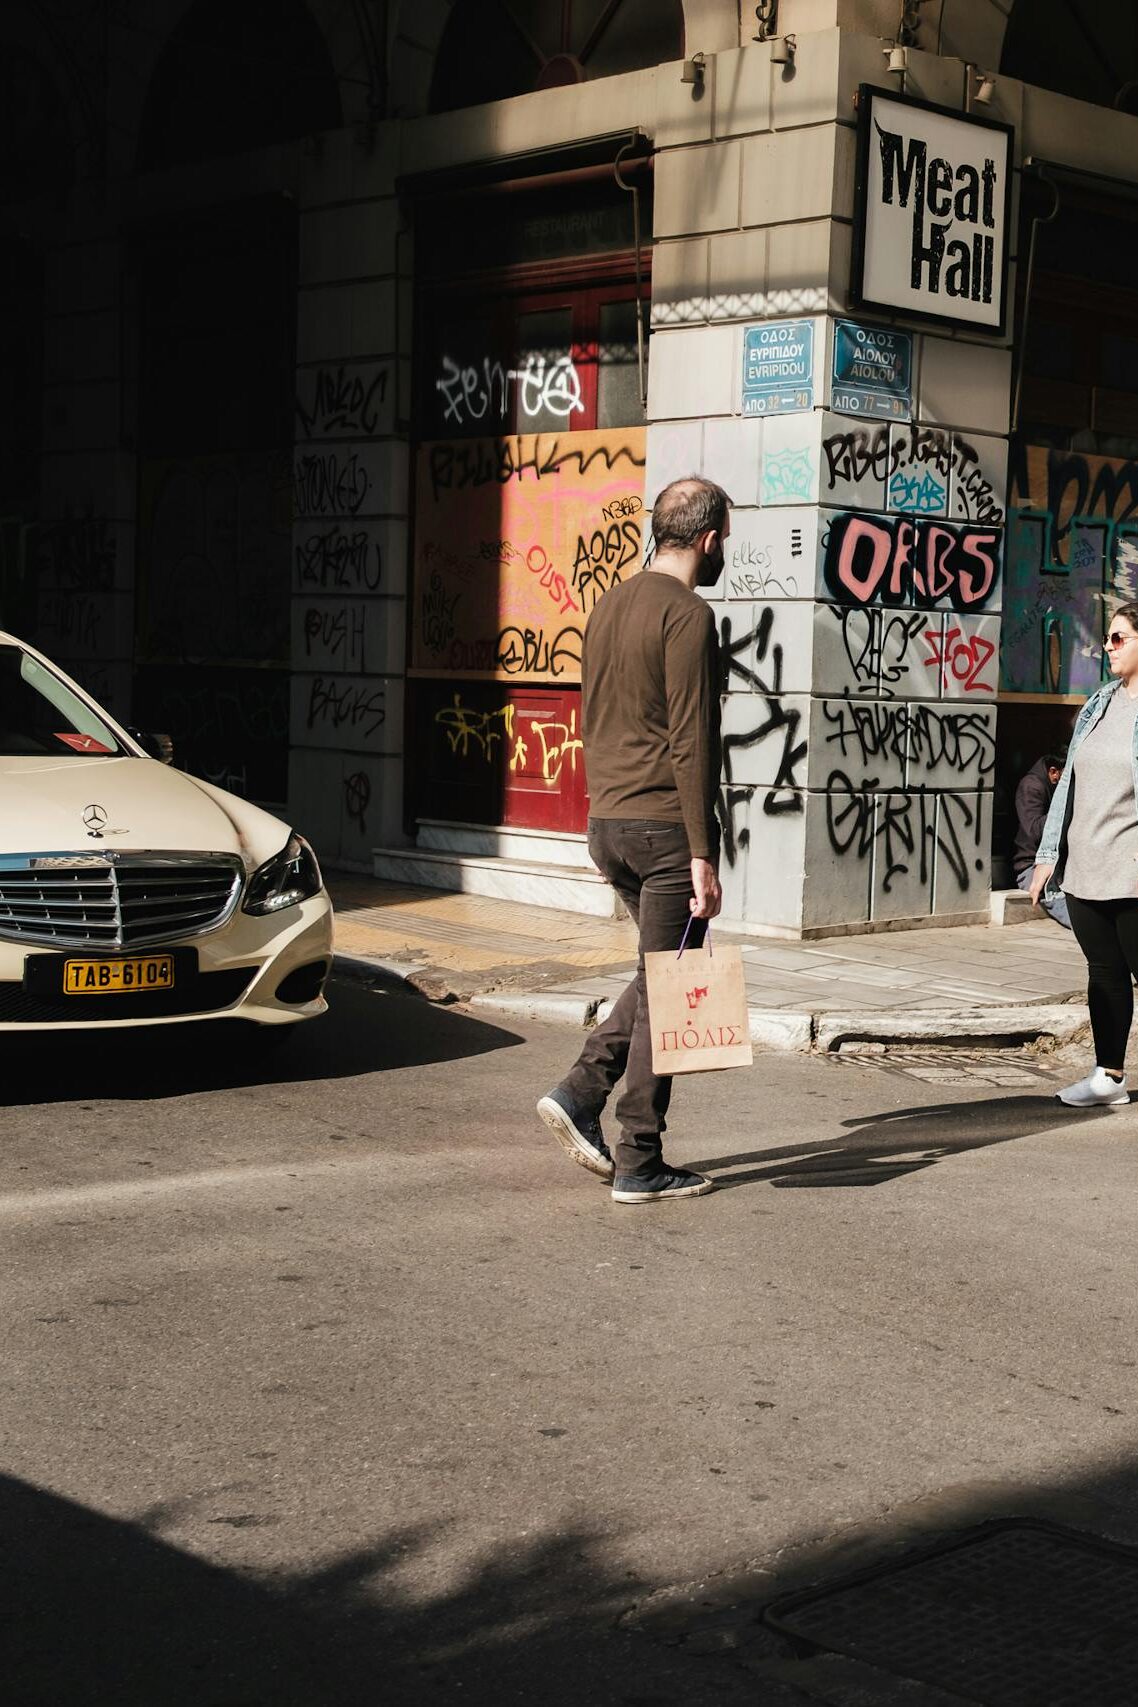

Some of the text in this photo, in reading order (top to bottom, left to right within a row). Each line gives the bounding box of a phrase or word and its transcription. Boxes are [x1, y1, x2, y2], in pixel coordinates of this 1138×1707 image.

[874, 117, 997, 229] Meat
[911, 213, 994, 304] Hall
[760, 329, 796, 344] ΟΔΟΣ
[856, 330, 895, 348] ΟΔΟΣ
[750, 344, 804, 361] ΕΥΡΙΠΙΔΟΥ
[853, 348, 896, 364] ΑΙΟΛΟΥ
[749, 363, 804, 379] EVRIPIDOU
[851, 366, 895, 382] AIOLOU
[745, 400, 766, 411] ΑΠΟ
[835, 395, 859, 410] ΑΠΟ
[72, 962, 170, 987] TAB-6104
